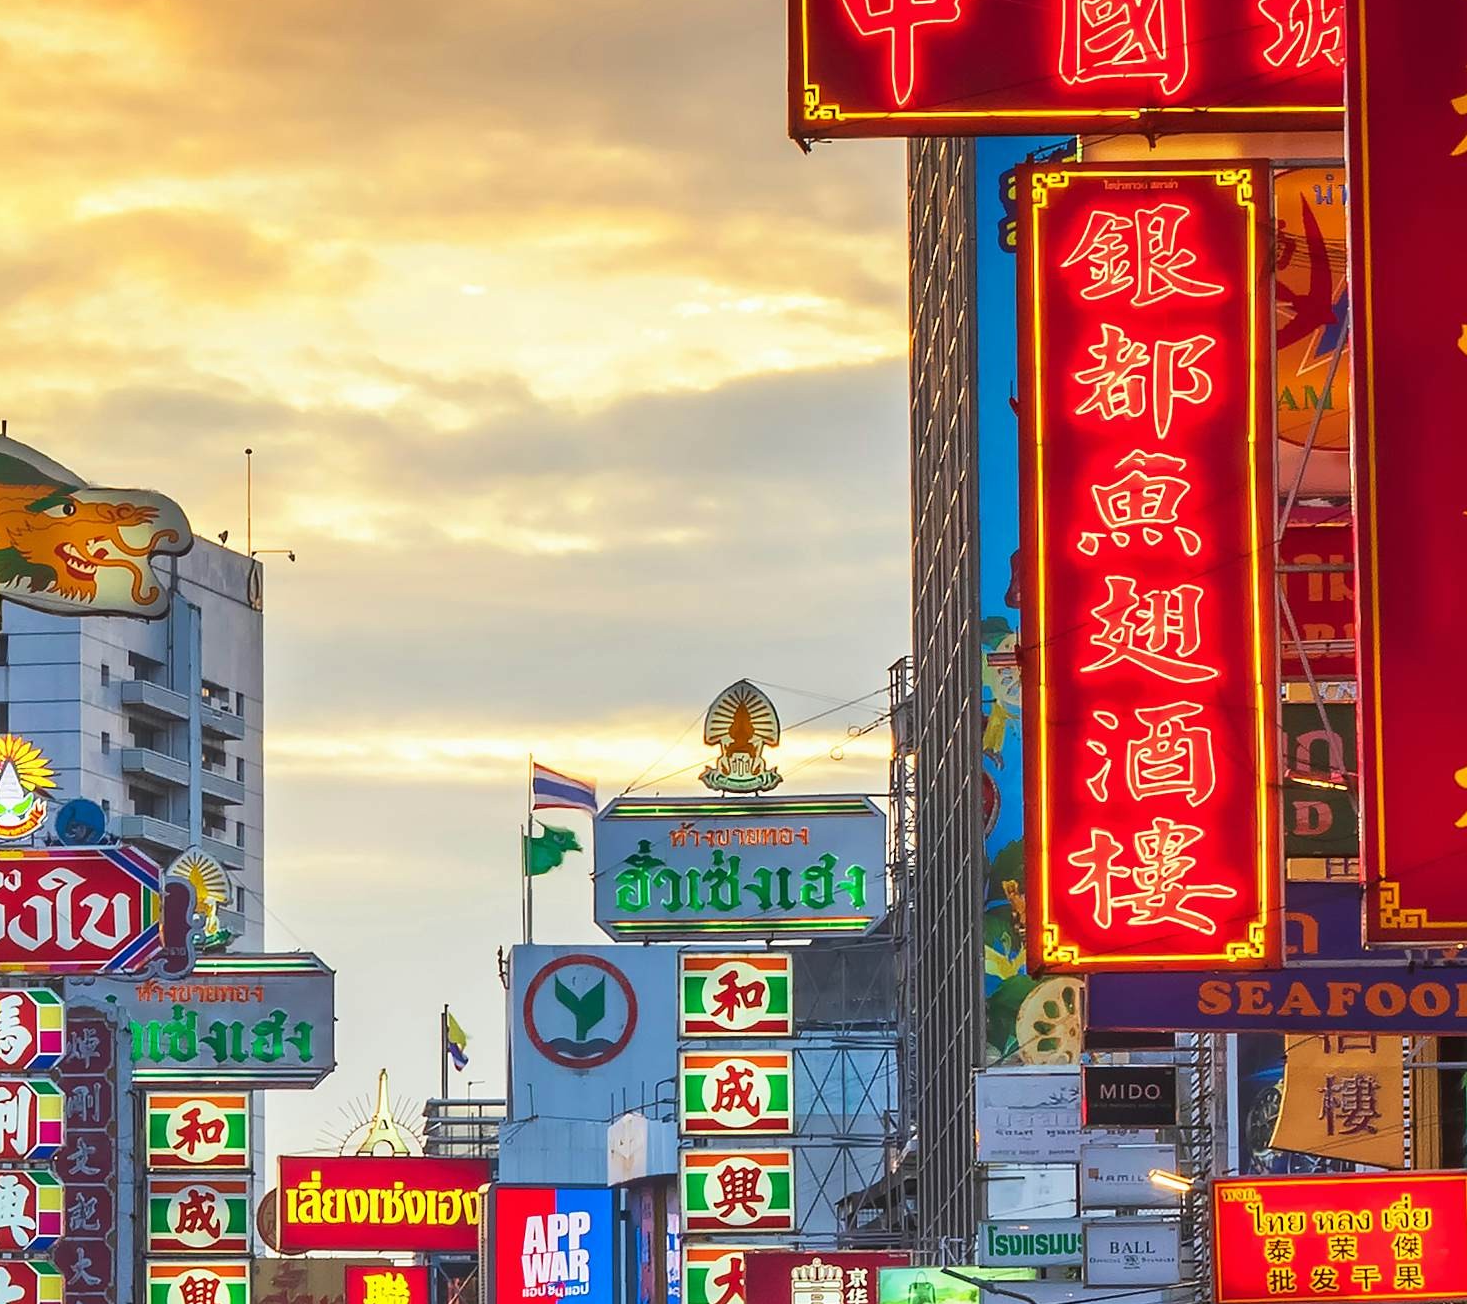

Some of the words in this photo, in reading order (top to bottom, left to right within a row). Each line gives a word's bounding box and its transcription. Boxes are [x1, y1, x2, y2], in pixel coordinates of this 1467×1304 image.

[1060, 204, 1237, 937] 銀都魚翅酒樓
[669, 823, 810, 849] ห้างขายทอง
[615, 840, 867, 912] ฮั่วเซ่งเฮง
[1100, 1084, 1161, 1101] MIDO
[524, 1212, 591, 1254] APP
[1248, 1203, 1306, 1234] ไทย
[1316, 1211, 1372, 1232] หลง
[1109, 1241, 1156, 1255] BALL
[521, 1249, 590, 1289] WAR
[1269, 1266, 1424, 1292] 批发干果
